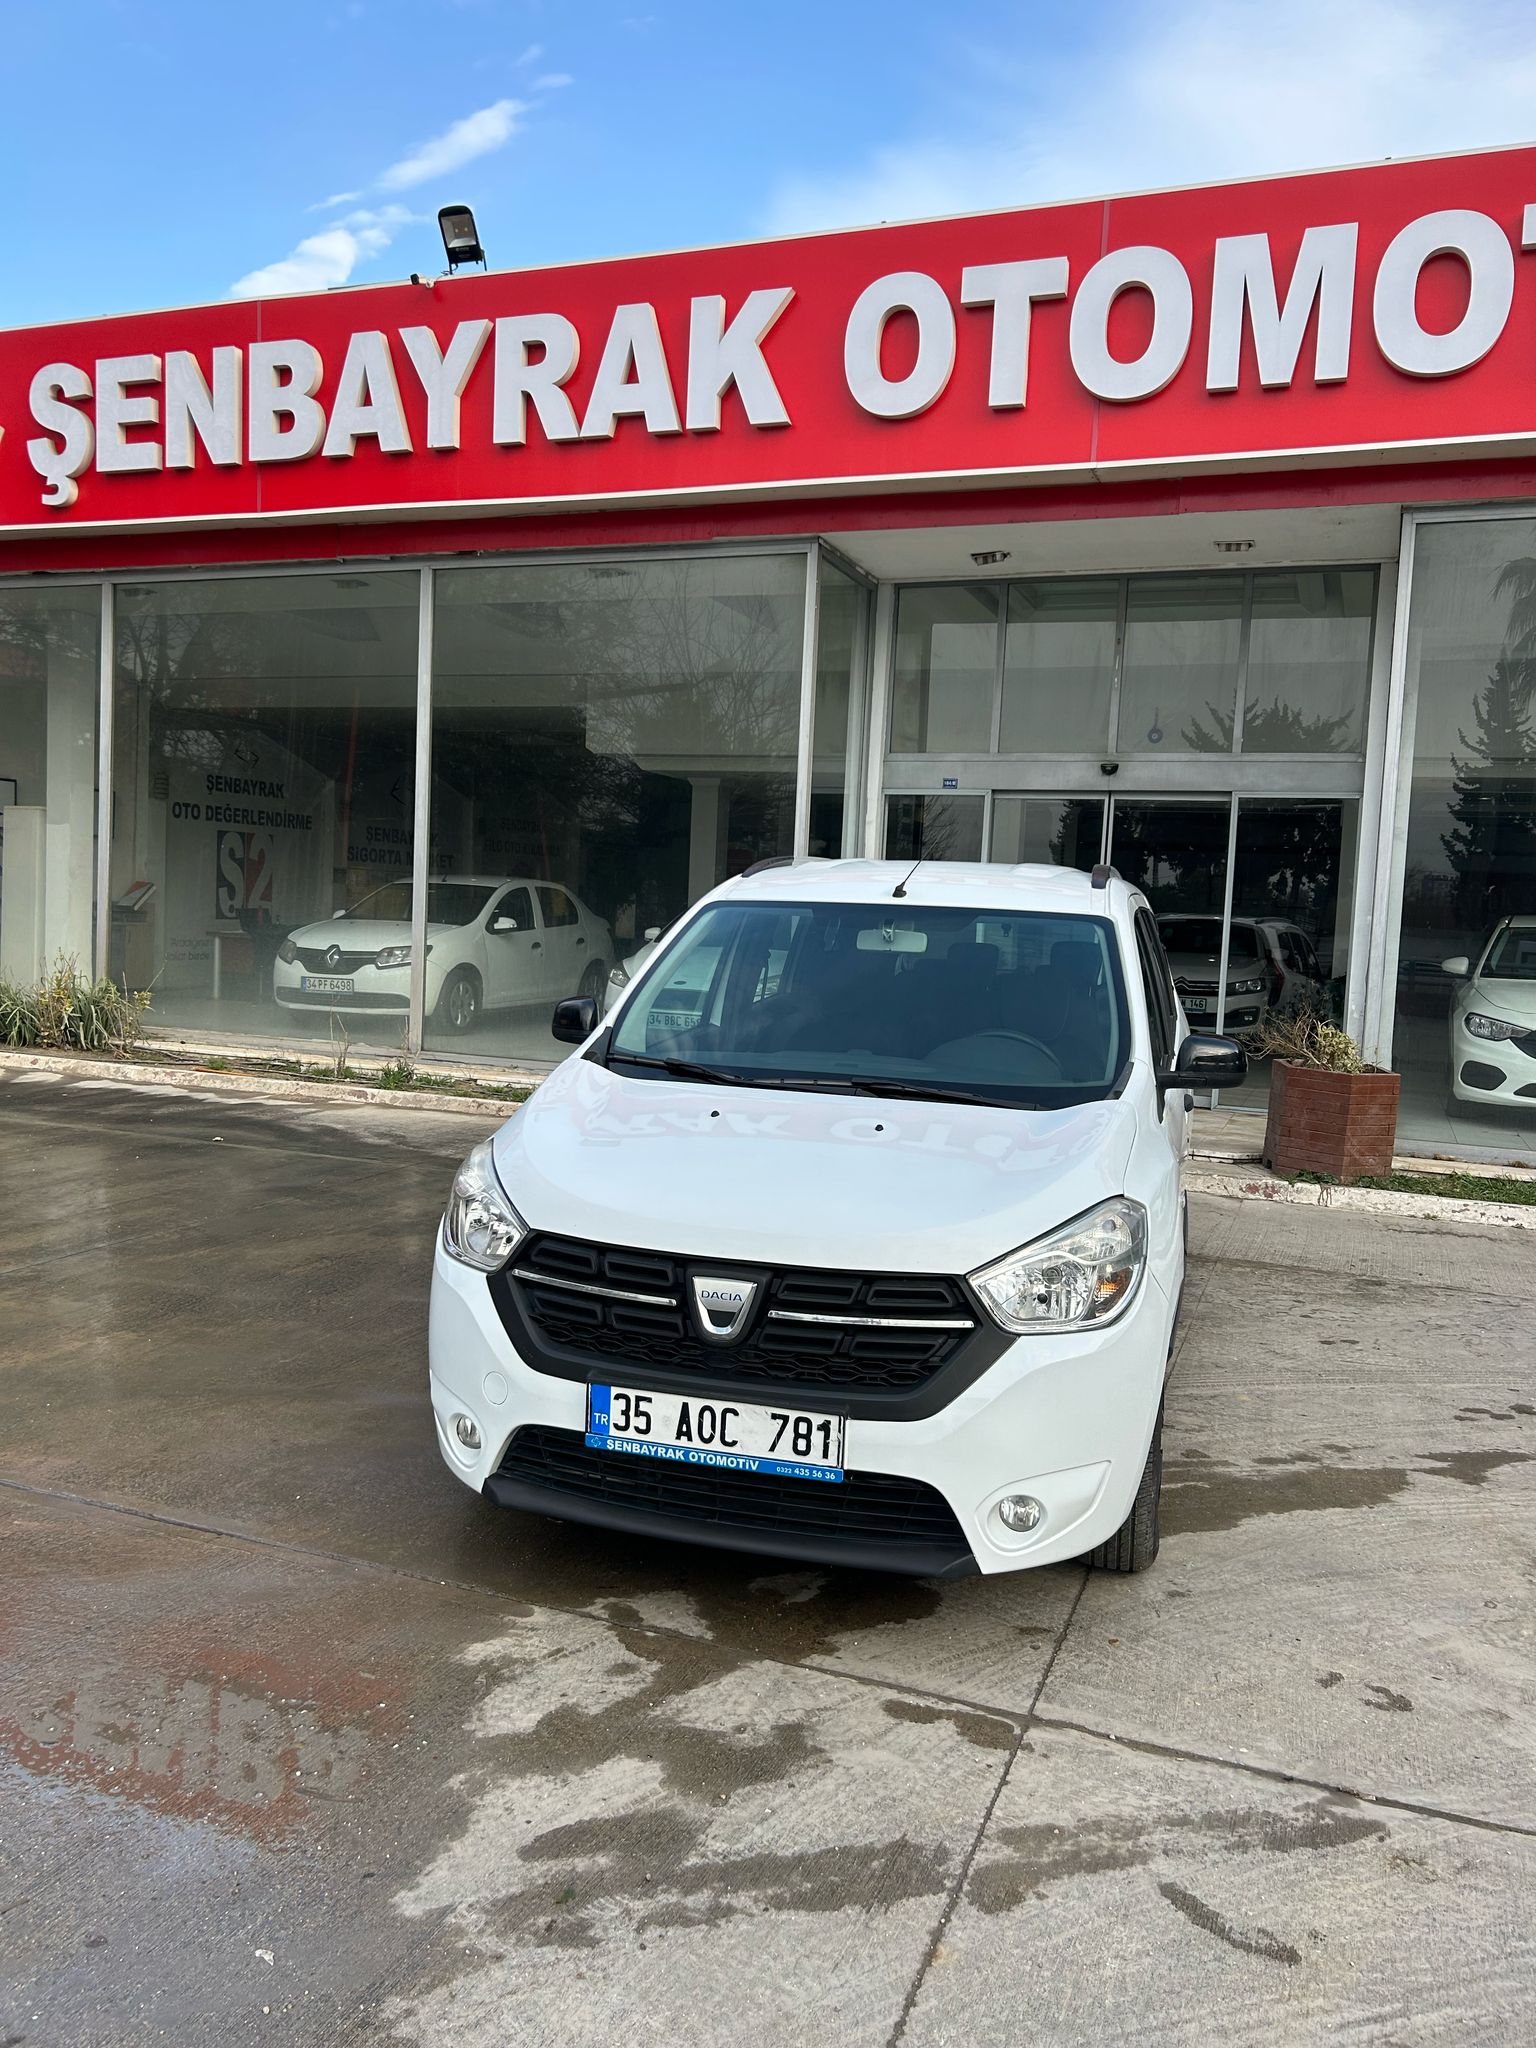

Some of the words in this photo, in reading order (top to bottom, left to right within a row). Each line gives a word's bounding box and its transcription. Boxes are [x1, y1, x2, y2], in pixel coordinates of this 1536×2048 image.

[27, 287, 796, 508] ŞENBAYRAK
[844, 202, 1536, 420] OTOMO
[206, 774, 285, 799] ŞENBAYRAK
[172, 801, 201, 821] OTO
[205, 803, 313, 831] DEĞERLENDİRME
[307, 979, 317, 989] 34
[318, 979, 328, 990] PF
[330, 980, 352, 991] 6498
[650, 1015, 661, 1025] 34
[665, 1016, 682, 1026] BBC
[701, 1289, 743, 1303] DACIA
[593, 1412, 608, 1426] TR
[612, 1392, 653, 1436] 35
[675, 1401, 740, 1448] AOC
[768, 1412, 832, 1460] 781
[776, 1466, 792, 1474] 0322
[794, 1467, 810, 1477] 435
[812, 1470, 823, 1479] 56
[825, 1471, 836, 1480] 36
